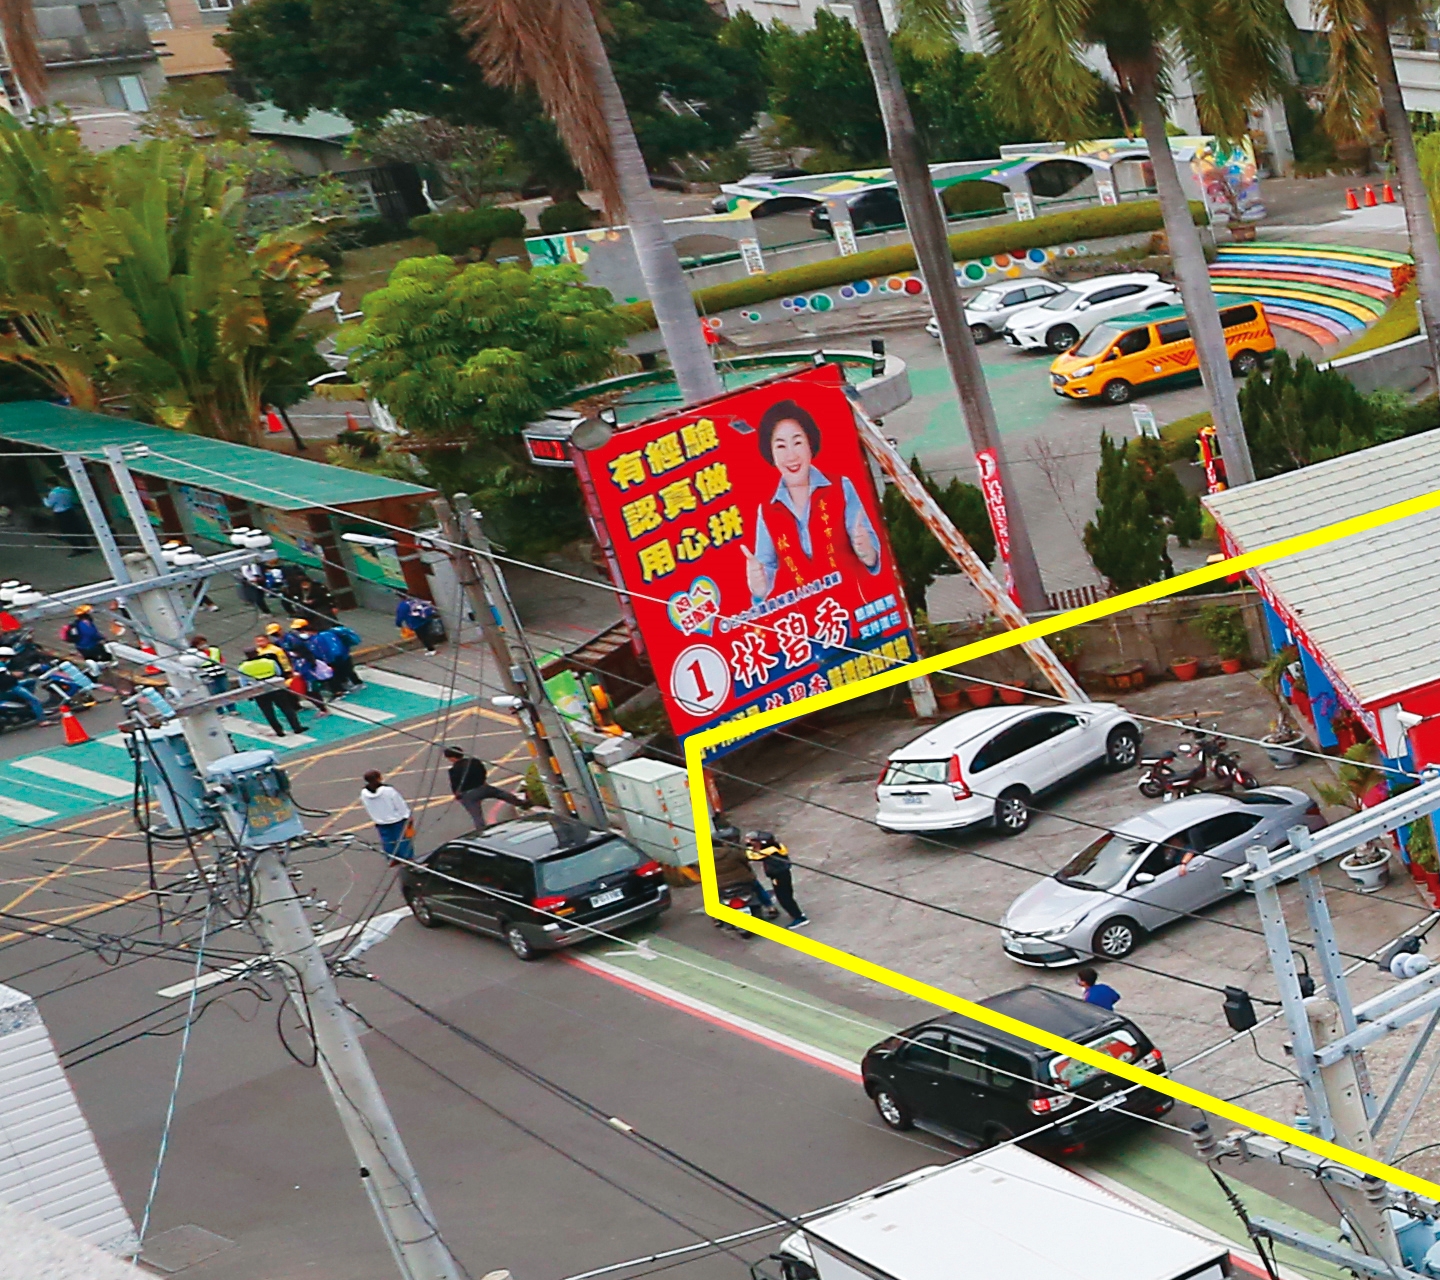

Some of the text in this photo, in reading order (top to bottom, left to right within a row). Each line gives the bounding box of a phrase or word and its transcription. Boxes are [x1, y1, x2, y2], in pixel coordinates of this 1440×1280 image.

[608, 418, 720, 490] 有經驗
[621, 462, 732, 539] 認真做
[637, 505, 744, 583] 用心拼
[687, 659, 714, 702] 1
[731, 598, 848, 688] 林碧秀
